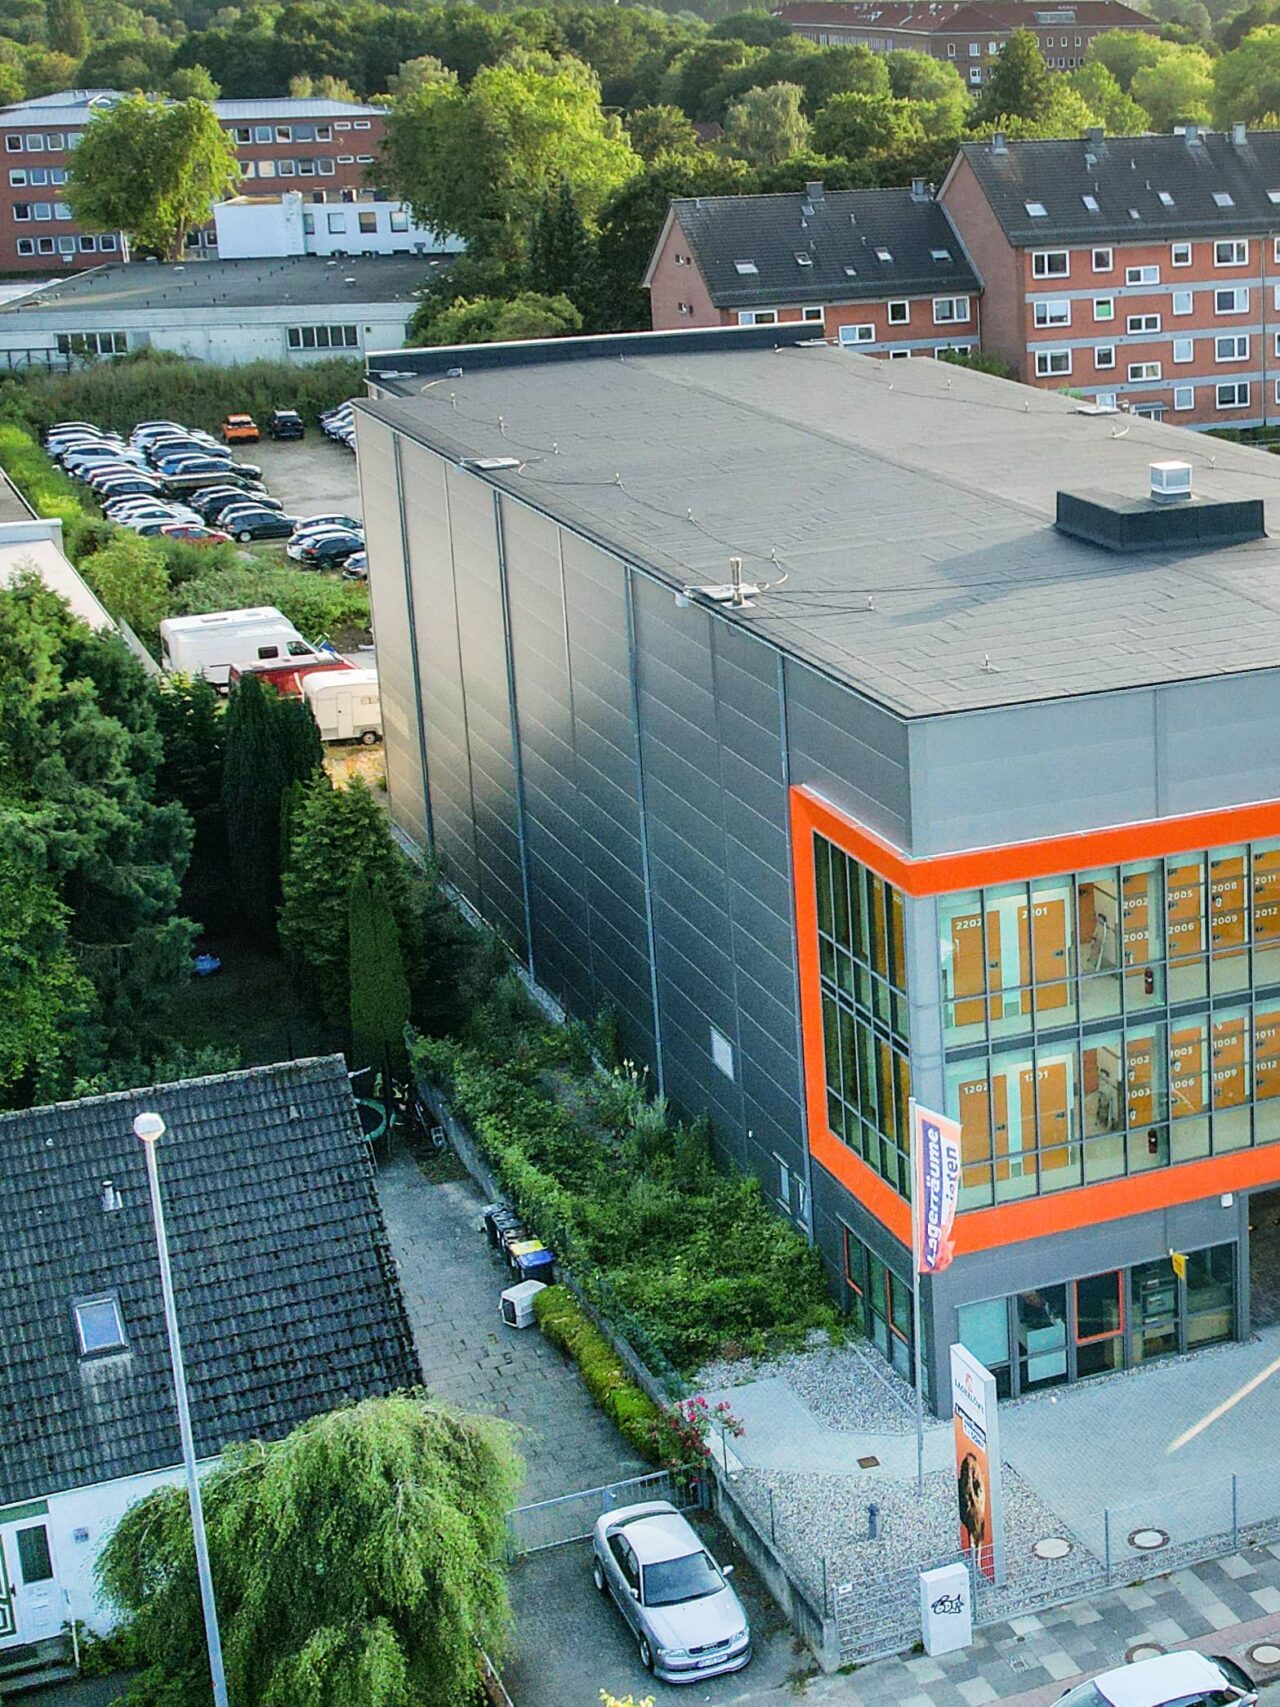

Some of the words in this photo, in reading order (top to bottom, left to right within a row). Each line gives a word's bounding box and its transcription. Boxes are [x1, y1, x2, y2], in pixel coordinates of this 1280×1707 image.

[1255, 875, 1276, 886] 2011
[1212, 881, 1238, 893] 2008
[1167, 889, 1193, 902] 2005
[1123, 897, 1149, 909] 2002
[1021, 906, 1048, 919] 201
[1255, 907, 1278, 918] 2012
[1212, 914, 1238, 926] 2009
[1168, 922, 1194, 934] 2006
[1255, 1029, 1276, 1040] 1011
[1213, 1036, 1237, 1049] 1008
[1170, 1046, 1193, 1059] 1005
[1256, 1060, 1277, 1071] 1012
[1213, 1068, 1237, 1081] 1009
[1171, 1078, 1195, 1090] 1006
